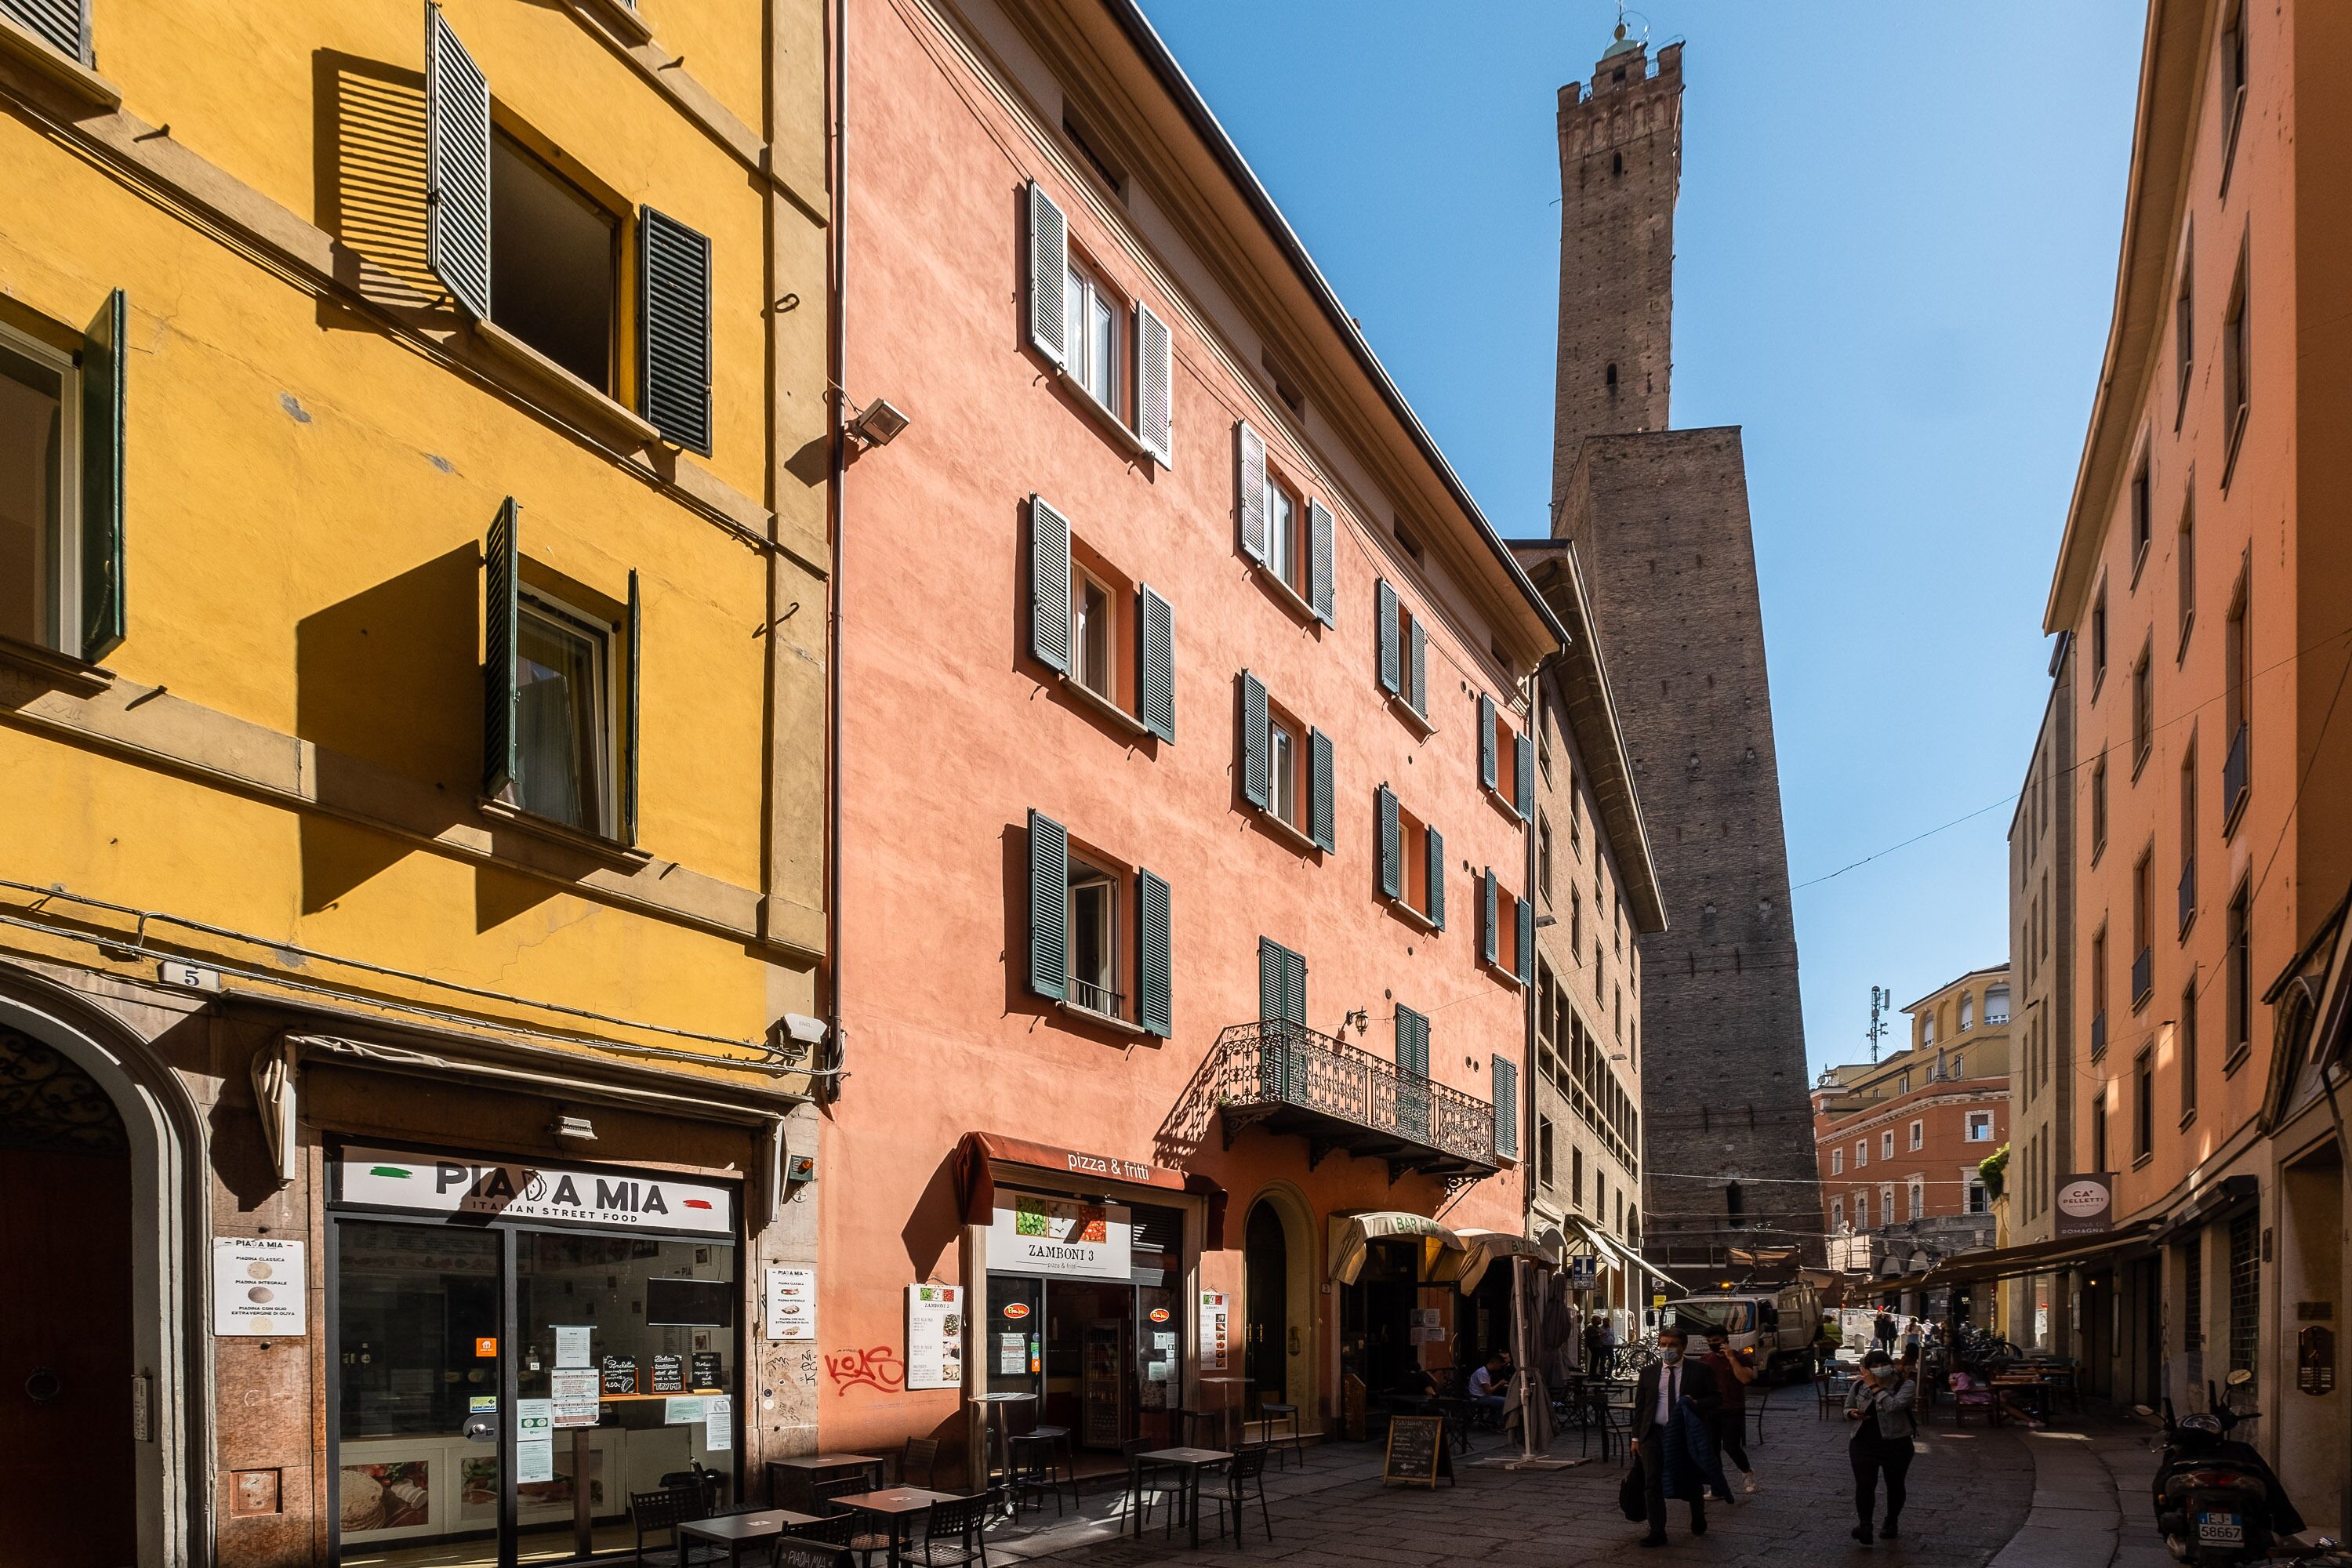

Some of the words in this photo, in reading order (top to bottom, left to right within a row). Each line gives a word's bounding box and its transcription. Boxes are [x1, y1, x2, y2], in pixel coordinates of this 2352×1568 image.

[184, 970, 199, 986] 5
[1067, 1152, 1107, 1172] pizza
[1111, 1158, 1121, 1175] &
[1123, 1161, 1149, 1180] fritti
[596, 1178, 669, 1215] MIA
[473, 1200, 534, 1214] ITALIAN
[543, 1207, 595, 1219] STREET
[603, 1213, 637, 1222] FOOD
[1396, 1217, 1417, 1231] BAR
[1029, 1244, 1085, 1261] ZAMBONI
[1088, 1250, 1094, 1261] 3
[1576, 1256, 1592, 1273] T
[2201, 1526, 2241, 1538] 58667
